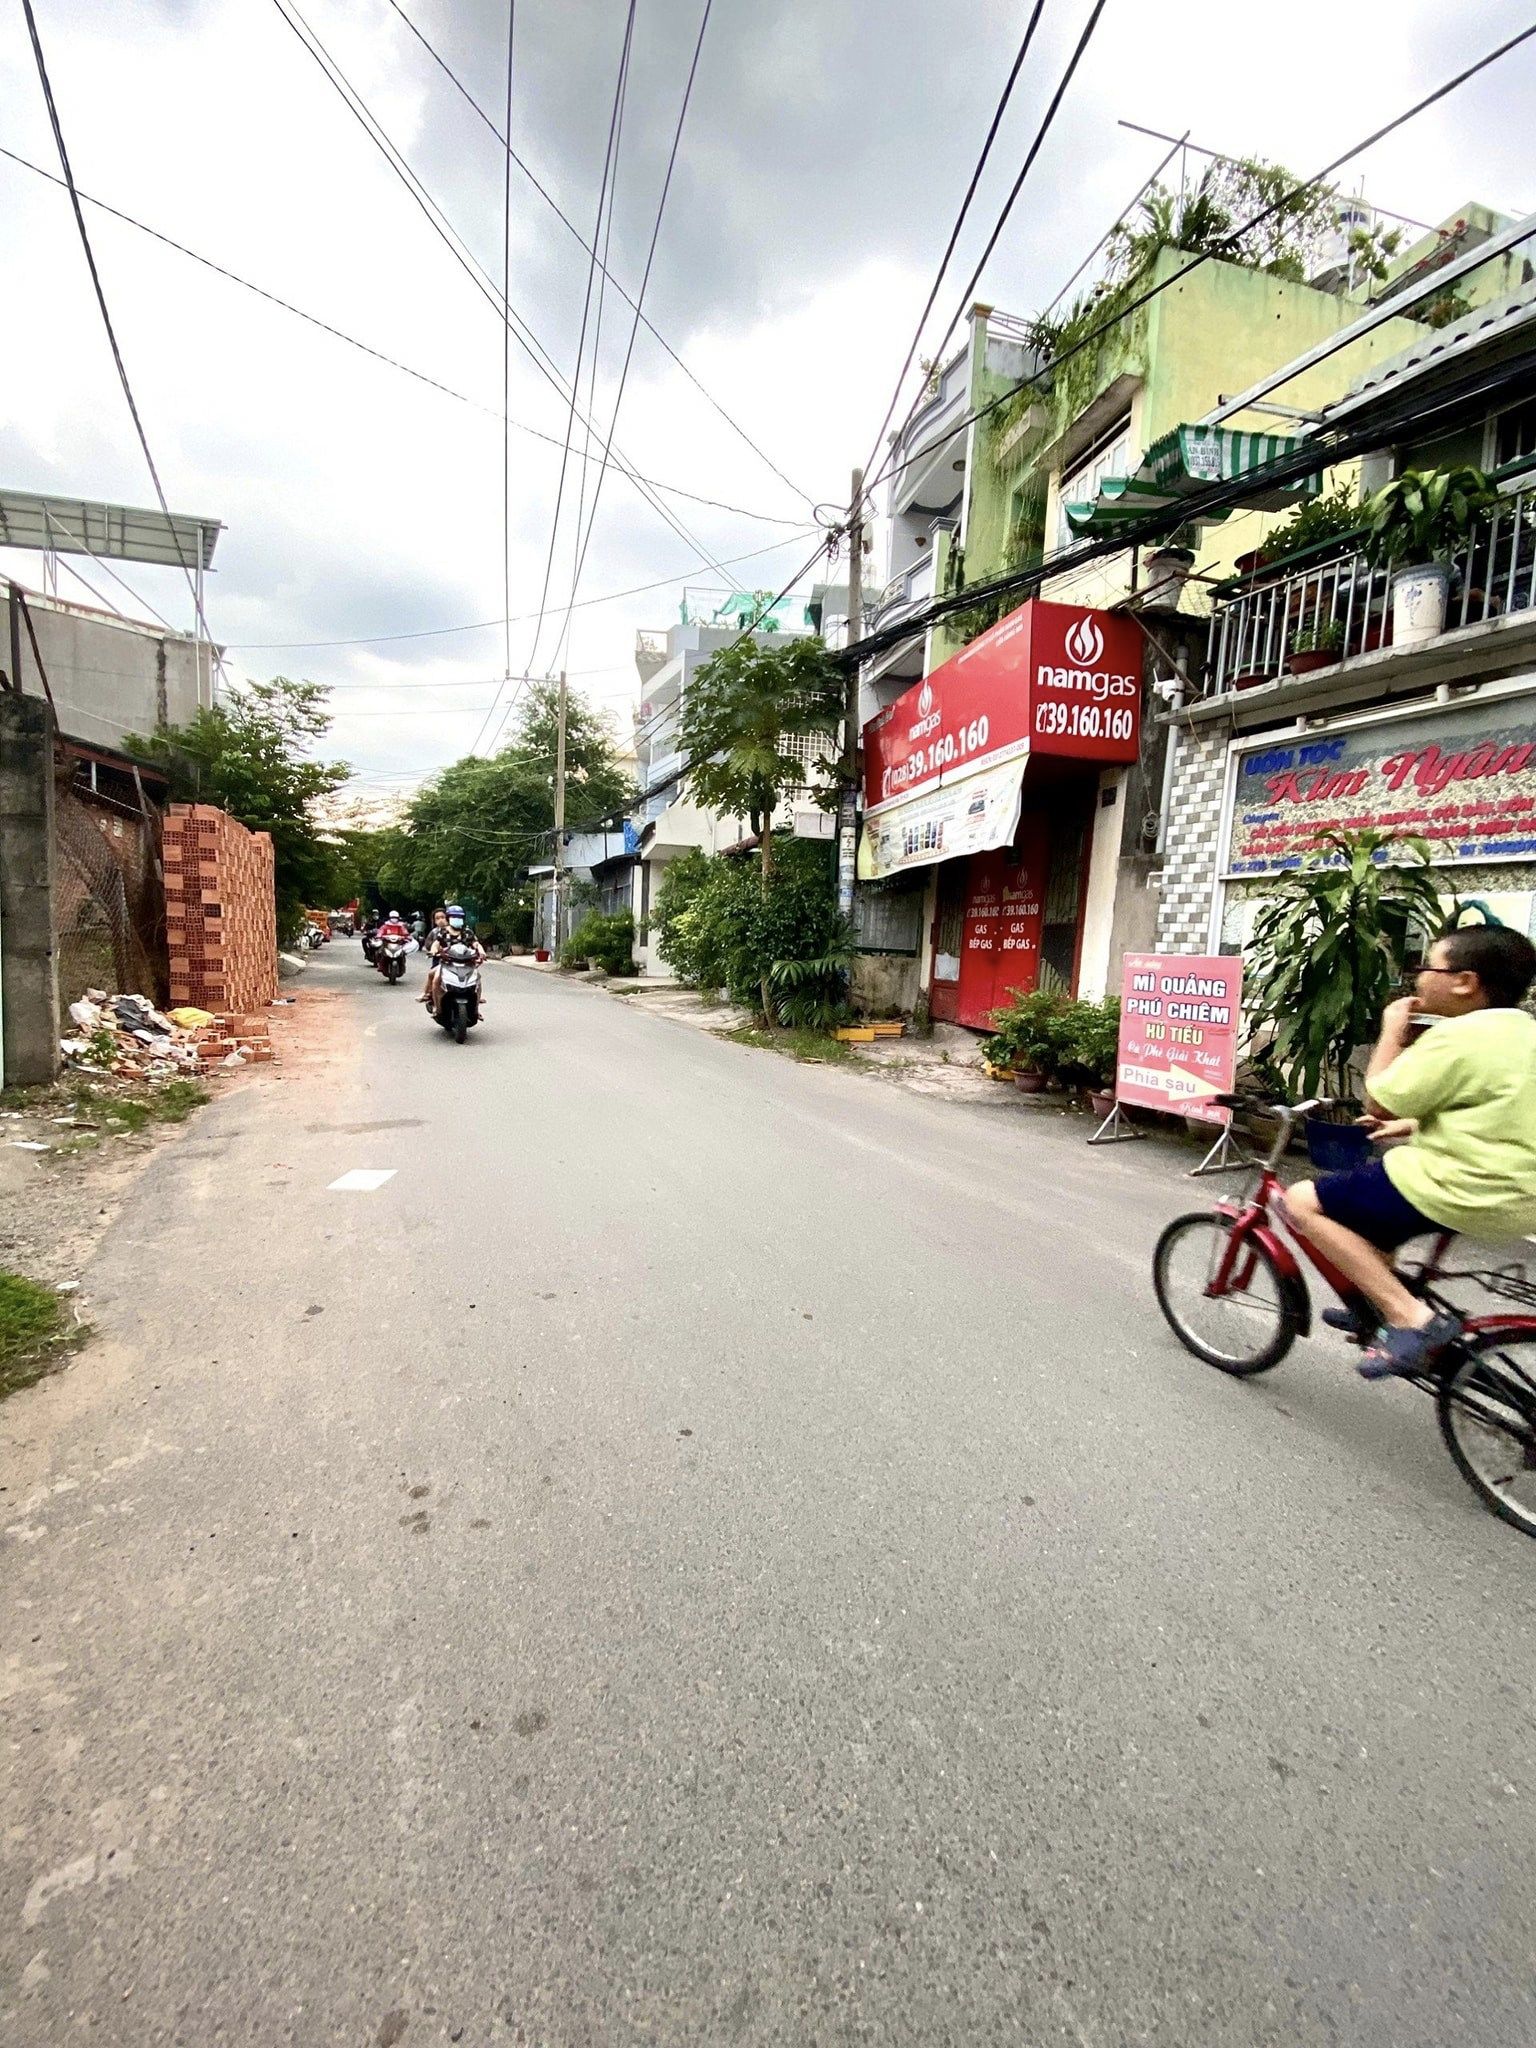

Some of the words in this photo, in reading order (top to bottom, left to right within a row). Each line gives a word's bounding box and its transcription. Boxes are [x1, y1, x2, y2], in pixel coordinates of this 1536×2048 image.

[1037, 665, 1136, 700] namgas
[908, 709, 941, 741] namgas
[1046, 703, 1133, 740] 39.160.160
[1263, 767, 1370, 807] Kim
[1381, 739, 1536, 797] Ngân
[975, 924, 988, 935] GAS
[1011, 923, 1024, 934] GAS
[1016, 938, 1030, 949] GAS
[1133, 972, 1156, 991] MÌ
[1160, 973, 1227, 999] QUẢNG
[1126, 997, 1163, 1016] PHÚ
[1167, 1001, 1230, 1024] CHIÊM
[1169, 1023, 1204, 1046] TIẾU
[1165, 1078, 1196, 1093] sau
